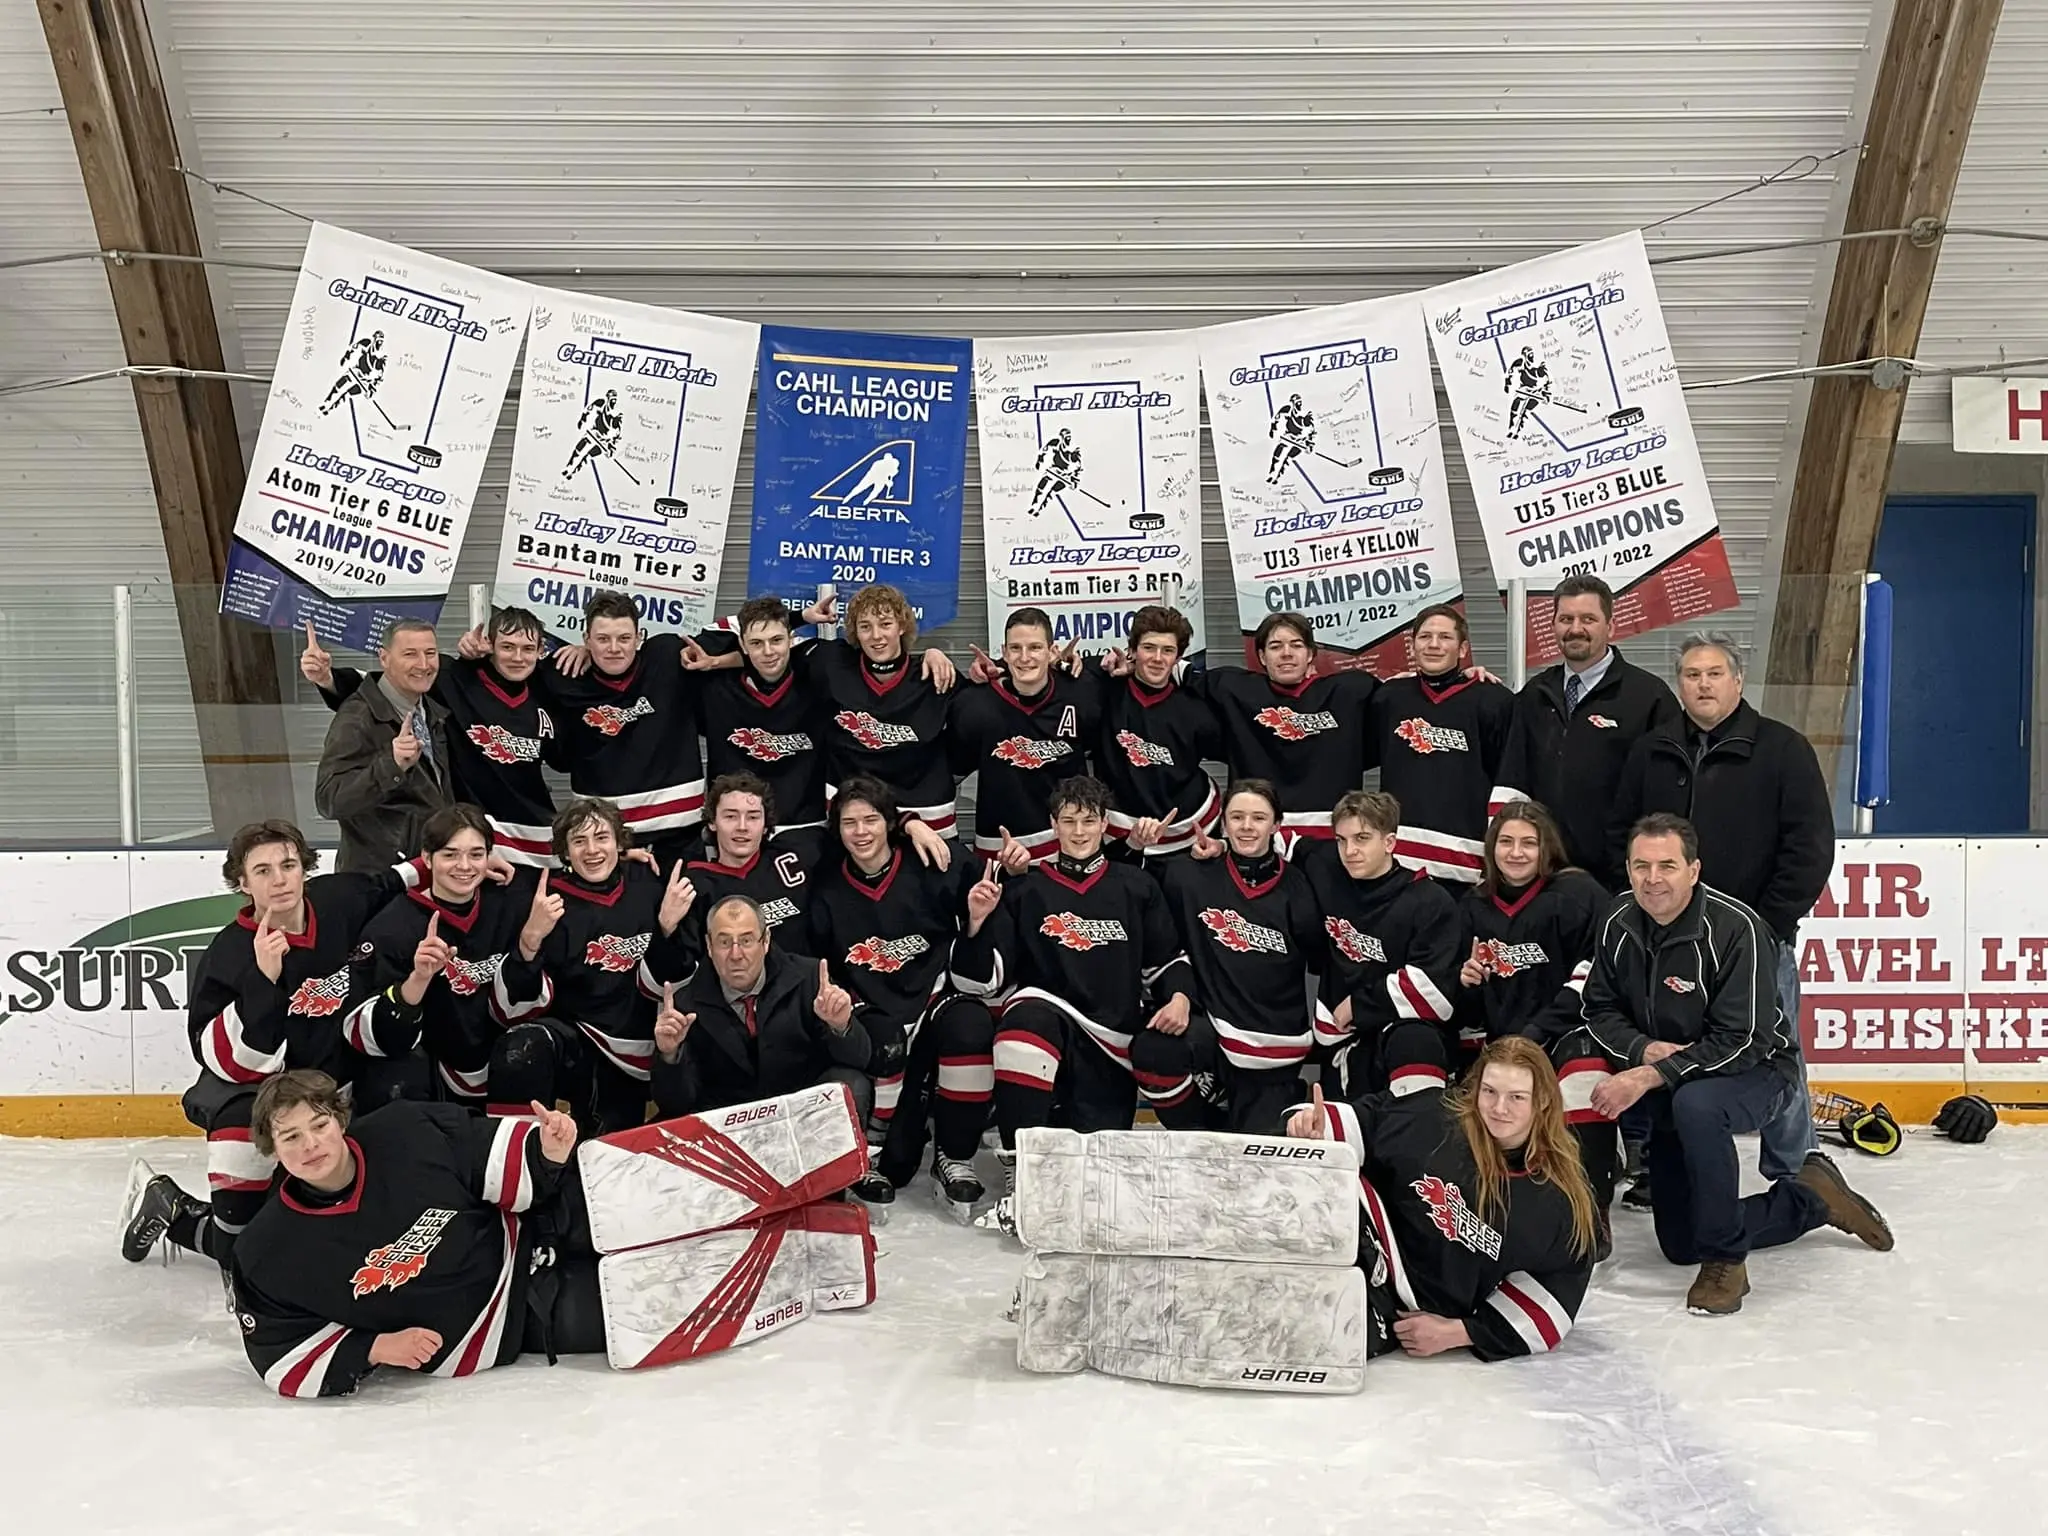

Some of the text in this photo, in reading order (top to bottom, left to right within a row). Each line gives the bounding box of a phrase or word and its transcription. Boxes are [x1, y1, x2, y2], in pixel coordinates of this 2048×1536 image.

[328, 279, 408, 316] Central
[408, 303, 487, 341] Alberta
[571, 312, 616, 330] NATHAN
[1459, 288, 1624, 346] Central Alberta
[557, 343, 717, 387] Central Alberta
[1006, 354, 1047, 366] NATHAN
[1230, 347, 1398, 386] Central Alberta
[776, 370, 844, 394] CAHL
[851, 376, 953, 401] LEAGUE
[1001, 393, 1084, 413] Central
[1088, 390, 1171, 409] Alberta
[796, 394, 930, 422] CHAMPION
[1611, 412, 1643, 427] CAHL
[2008, 389, 2048, 440] H
[286, 444, 446, 504] Hockey League
[409, 451, 440, 468] CAHL
[1500, 458, 1581, 494] Hockey
[1586, 434, 1667, 469] League
[1371, 475, 1403, 485] CAHL
[1514, 497, 1556, 524] U15
[1615, 465, 1667, 496] BLUE
[266, 467, 453, 536] Atom Tier 6 BLUE
[333, 507, 373, 528] League
[656, 505, 686, 518] CAHL
[808, 504, 910, 524] ALBERTA
[1254, 498, 1423, 537] Hockey League
[271, 509, 426, 574] CHAMPIONS
[535, 512, 696, 553] Hockey League
[1132, 520, 1163, 530] CAHL
[1518, 498, 1684, 567] CHAMPIONS
[517, 534, 706, 582] Bantam Tier 3
[779, 541, 931, 567] BANTAM TIER 3
[1009, 544, 1180, 565] Hockey League
[1264, 547, 1300, 570] U13
[1357, 528, 1420, 556] YELLOW
[1562, 558, 1598, 581] 2021
[1613, 543, 1653, 567] 2022
[294, 549, 387, 587] 2019/2020
[589, 568, 629, 586] League
[831, 564, 876, 583] 2020
[1008, 578, 1080, 598] Bantam
[1086, 575, 1120, 594] Tier
[1128, 573, 1138, 592] 3
[528, 578, 684, 625] CHAONS
[1265, 562, 1432, 613] CHAMPIONS
[1308, 612, 1341, 630] 2021
[1358, 603, 1398, 622] 2022
[538, 707, 555, 738] A
[1057, 705, 1077, 738] A
[775, 852, 806, 888] C
[1064, 920, 1121, 931] BEISEKER
[1078, 929, 1128, 941] BLAZERS
[1981, 937, 2048, 981] LT
[1814, 1007, 2048, 1050] BEISEKE
[375, 1208, 438, 1268] BEISEKER
[397, 1209, 458, 1264] BLAZERS
